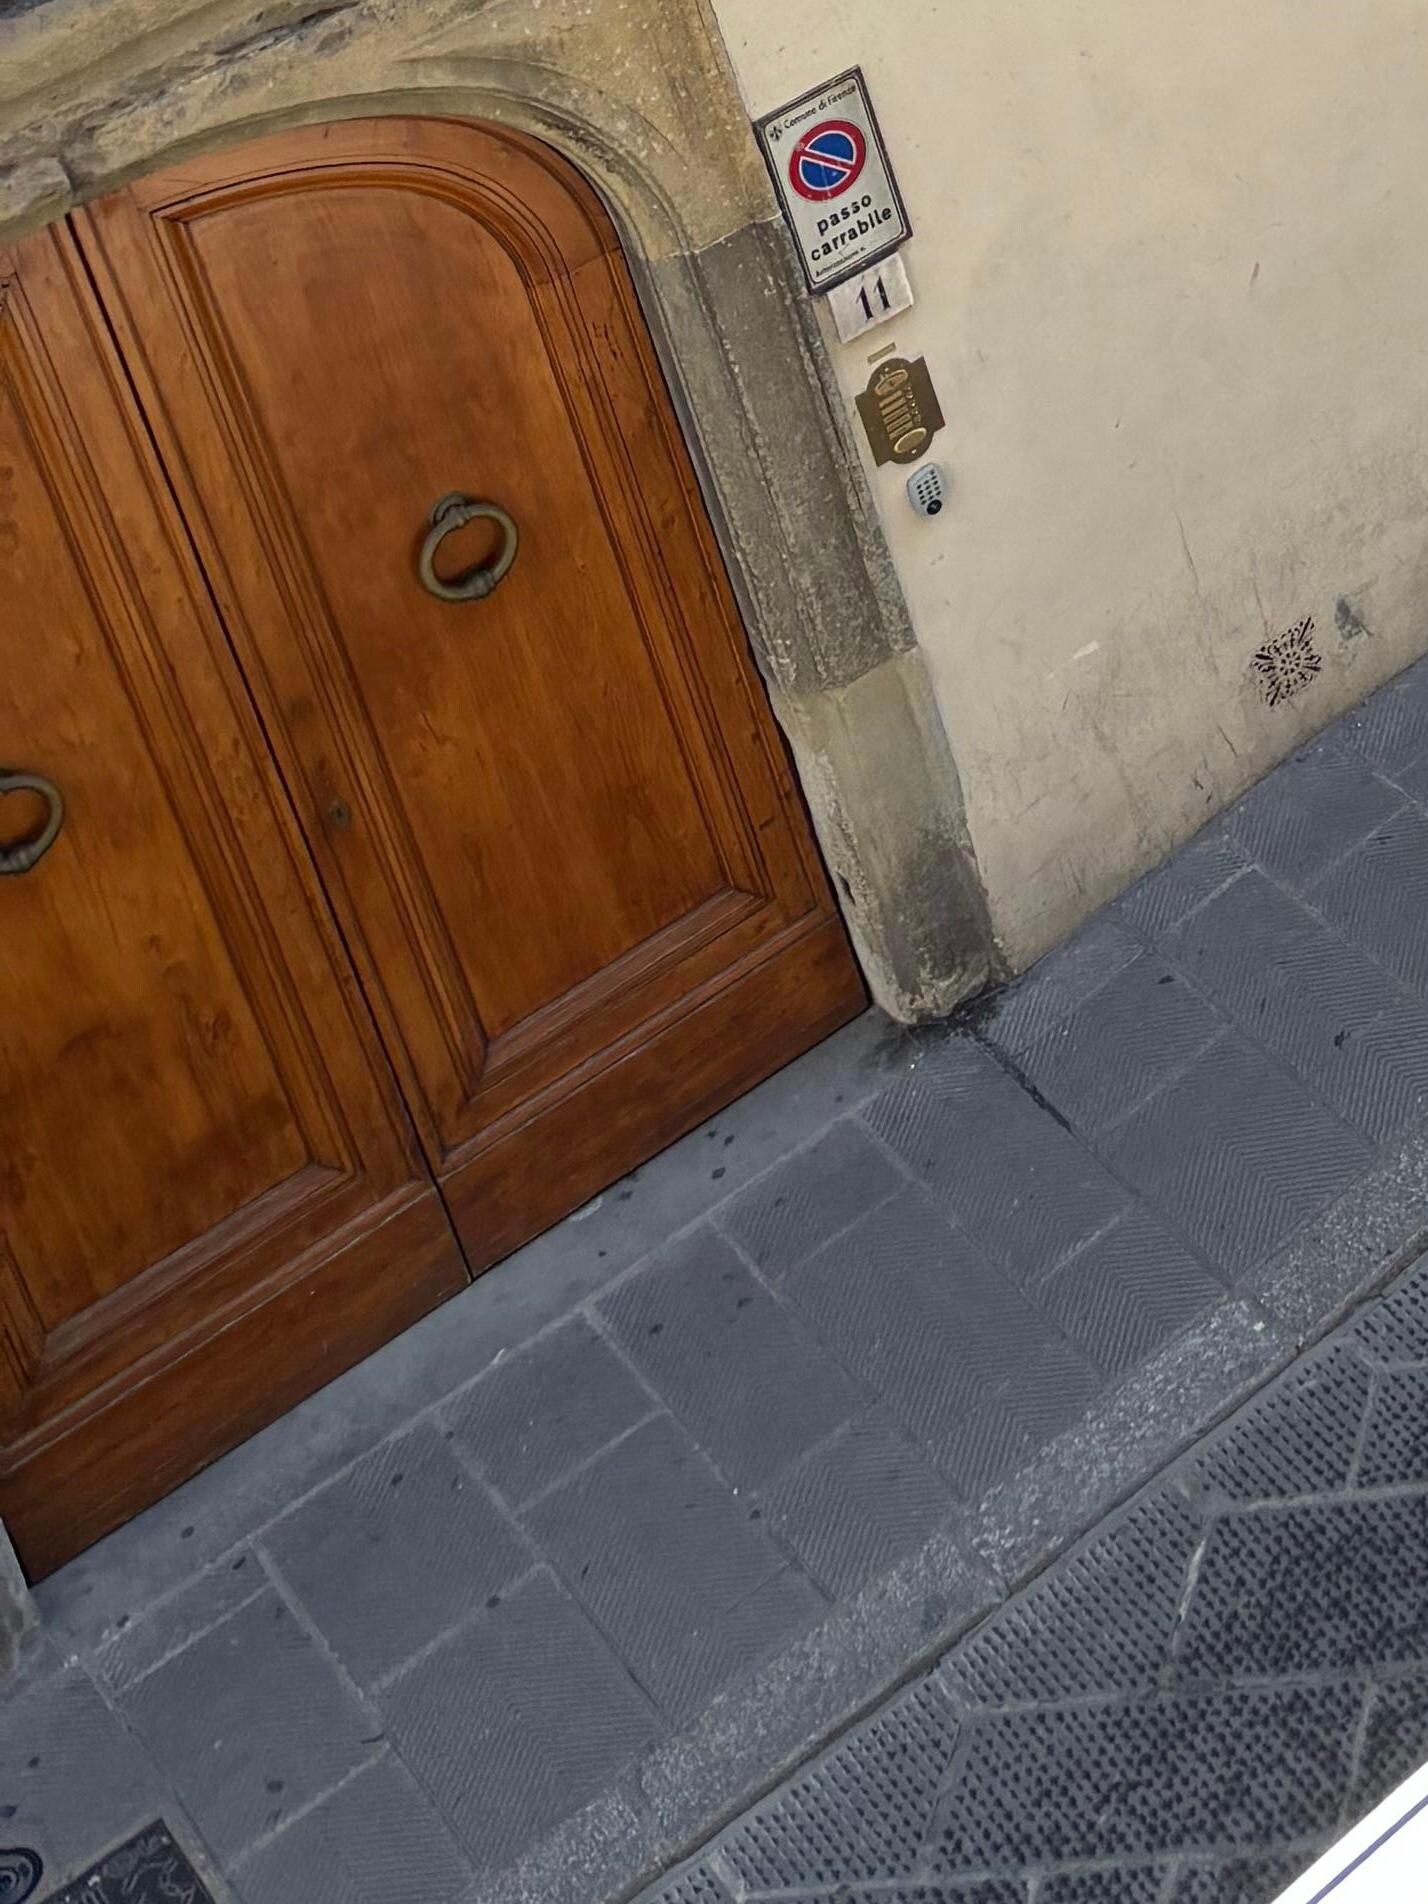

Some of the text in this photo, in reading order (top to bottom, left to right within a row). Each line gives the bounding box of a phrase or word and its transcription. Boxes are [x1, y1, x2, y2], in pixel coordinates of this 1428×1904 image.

[784, 84, 857, 130] Comune di Firenze
[811, 205, 892, 262] carrabile
[816, 194, 872, 236] passo
[855, 275, 891, 324] 11
